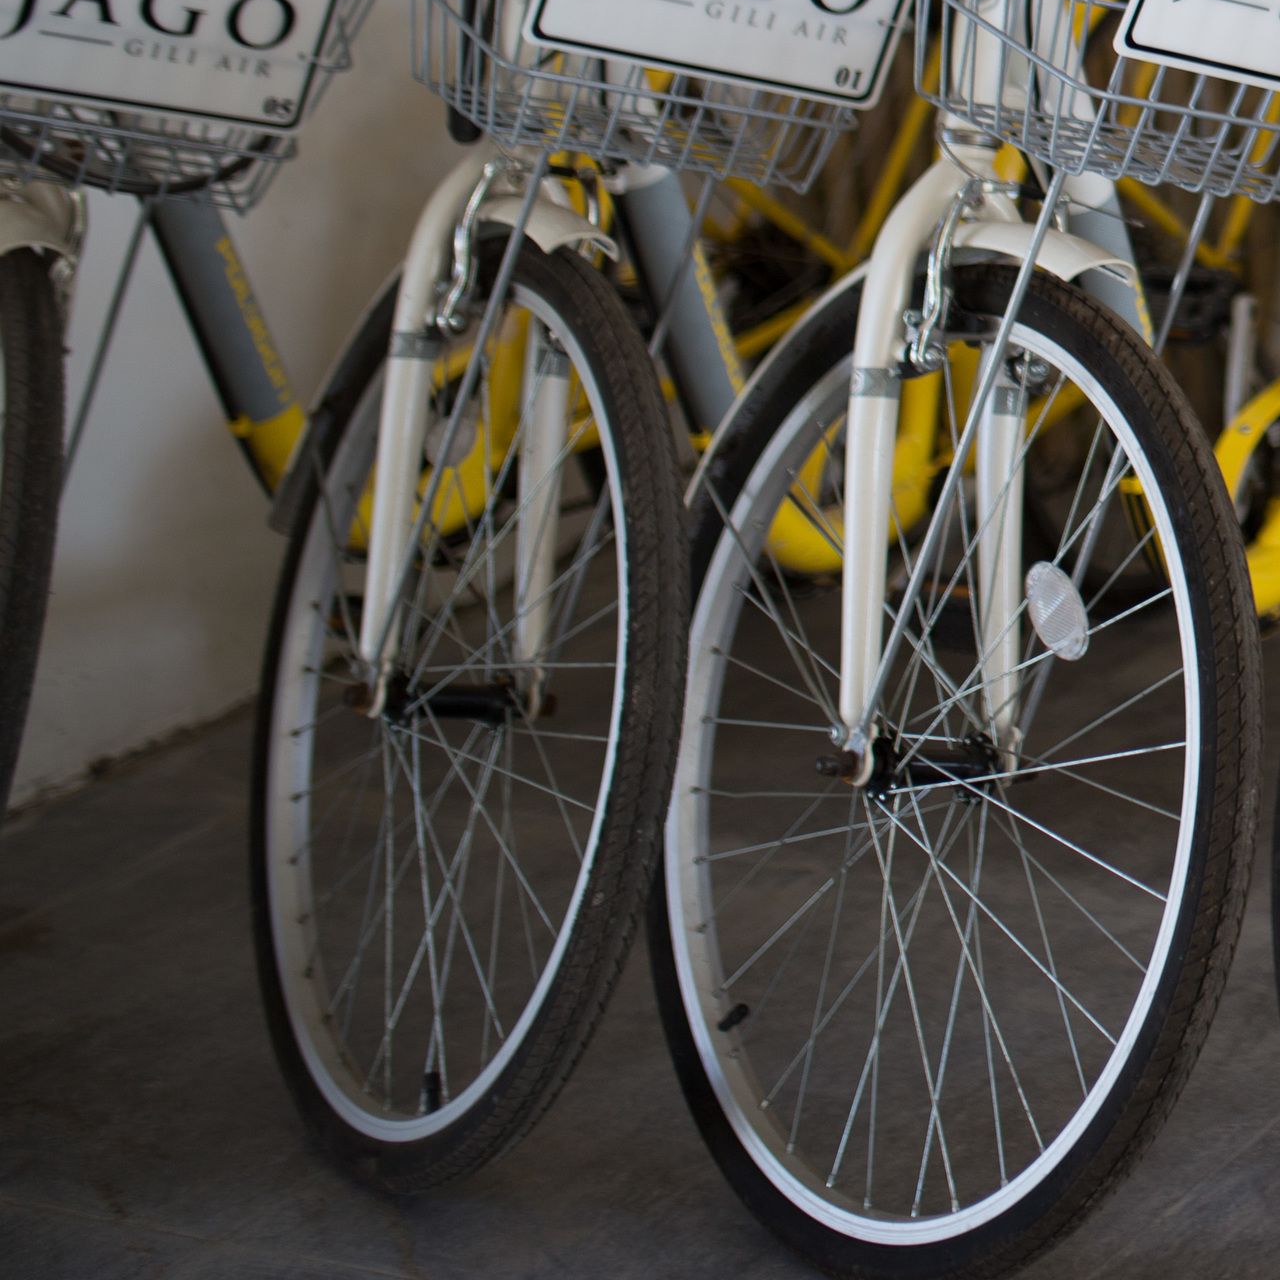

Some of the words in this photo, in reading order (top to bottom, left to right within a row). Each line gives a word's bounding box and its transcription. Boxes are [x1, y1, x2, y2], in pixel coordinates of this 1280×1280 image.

[705, 0, 777, 31] GILI
[793, 20, 848, 46] AIR
[124, 39, 198, 66] GILI
[214, 55, 271, 78] AIR
[834, 65, 863, 91] 01
